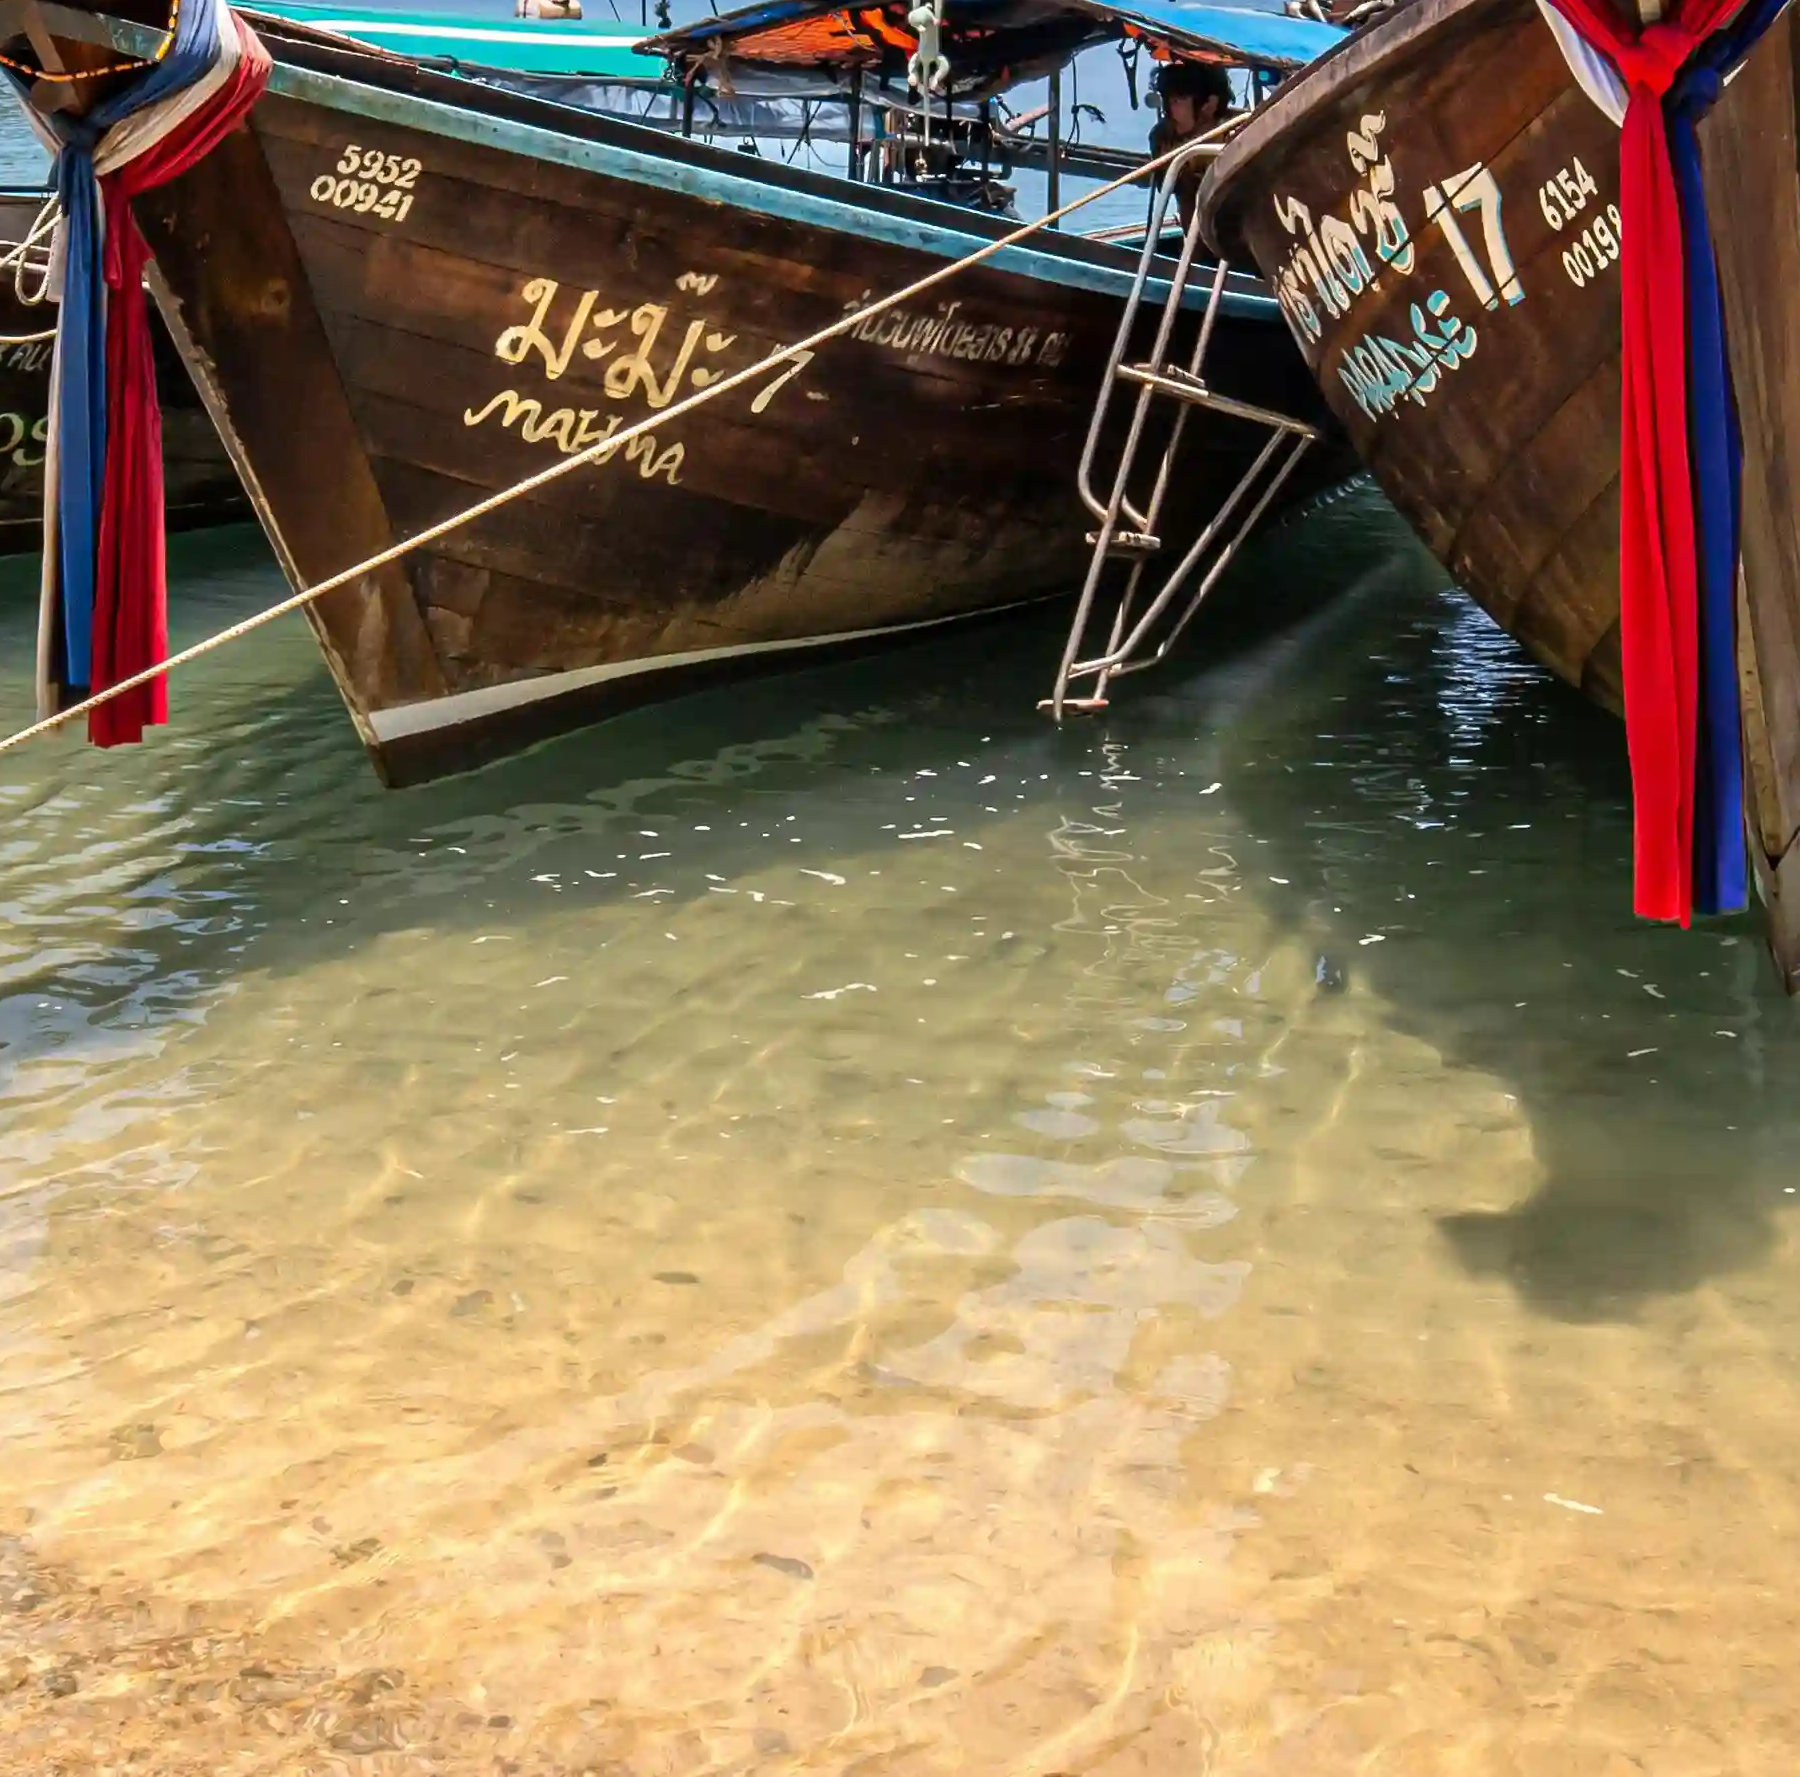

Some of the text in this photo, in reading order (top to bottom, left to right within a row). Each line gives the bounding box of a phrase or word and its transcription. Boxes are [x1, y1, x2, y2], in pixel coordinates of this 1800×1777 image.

[337, 144, 423, 190] 5952
[1539, 155, 1599, 232] 6154
[310, 175, 415, 222] 00941
[1422, 161, 1526, 312] 17
